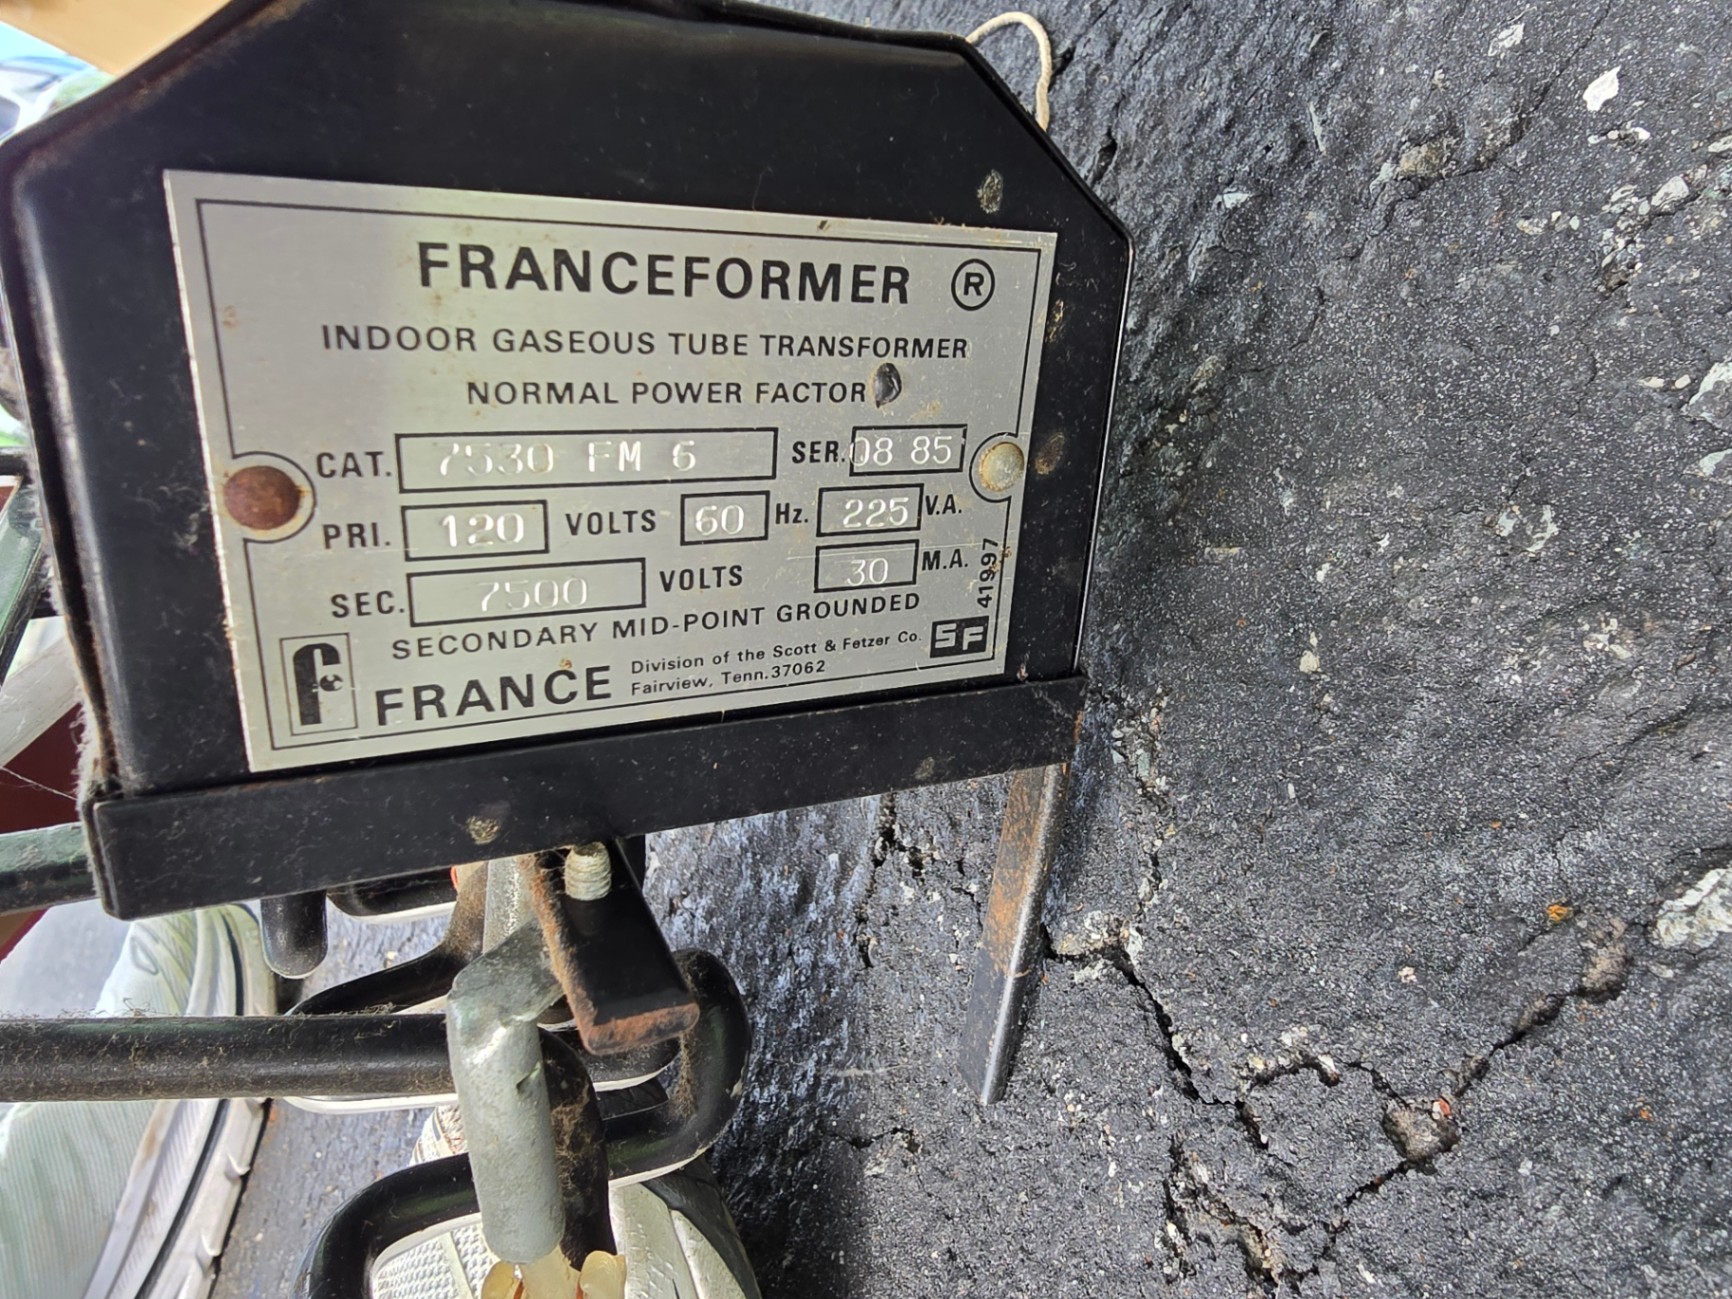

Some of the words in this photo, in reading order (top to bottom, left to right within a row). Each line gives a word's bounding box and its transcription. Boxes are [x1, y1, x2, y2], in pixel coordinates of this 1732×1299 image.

[419, 241, 910, 305] FRANCEFORMER
[322, 325, 478, 353] INDOOR
[492, 328, 655, 355] GASEOUS
[668, 332, 748, 356] TUBE
[759, 334, 968, 358] TRANSFORMER
[467, 381, 619, 405] NORMAL
[632, 381, 742, 404] POWER
[755, 381, 866, 404] FACTOR
[316, 451, 391, 479] CAT.
[438, 441, 555, 477] 7530
[587, 440, 642, 473] FM
[672, 439, 696, 471] 6
[791, 441, 846, 465] SER.
[910, 435, 952, 465] 85
[322, 522, 391, 550] PRI.
[442, 512, 525, 548] 120
[565, 508, 657, 537] VOLTS
[695, 504, 745, 536] 60
[775, 502, 809, 525] Hz.
[842, 496, 910, 529] 225
[925, 494, 962, 516] V.A.
[330, 589, 405, 619] SEC.
[477, 576, 588, 613] 7500
[659, 564, 744, 592] VOLTS
[847, 557, 889, 587] 30
[921, 549, 968, 571] M.A.
[977, 537, 999, 609] 41997
[392, 622, 598, 660] SECONDARY
[612, 606, 765, 639] MID-POINT
[776, 592, 921, 624] GROUNDED
[933, 621, 987, 651] SF
[631, 652, 707, 675] Division
[713, 649, 731, 664] of
[737, 647, 765, 661] the
[772, 641, 818, 659] Scott
[825, 639, 836, 652] &
[843, 634, 890, 651] Fetzer
[898, 630, 922, 645] Co.
[375, 665, 612, 727] FRANCE
[631, 676, 714, 697] Fairview,
